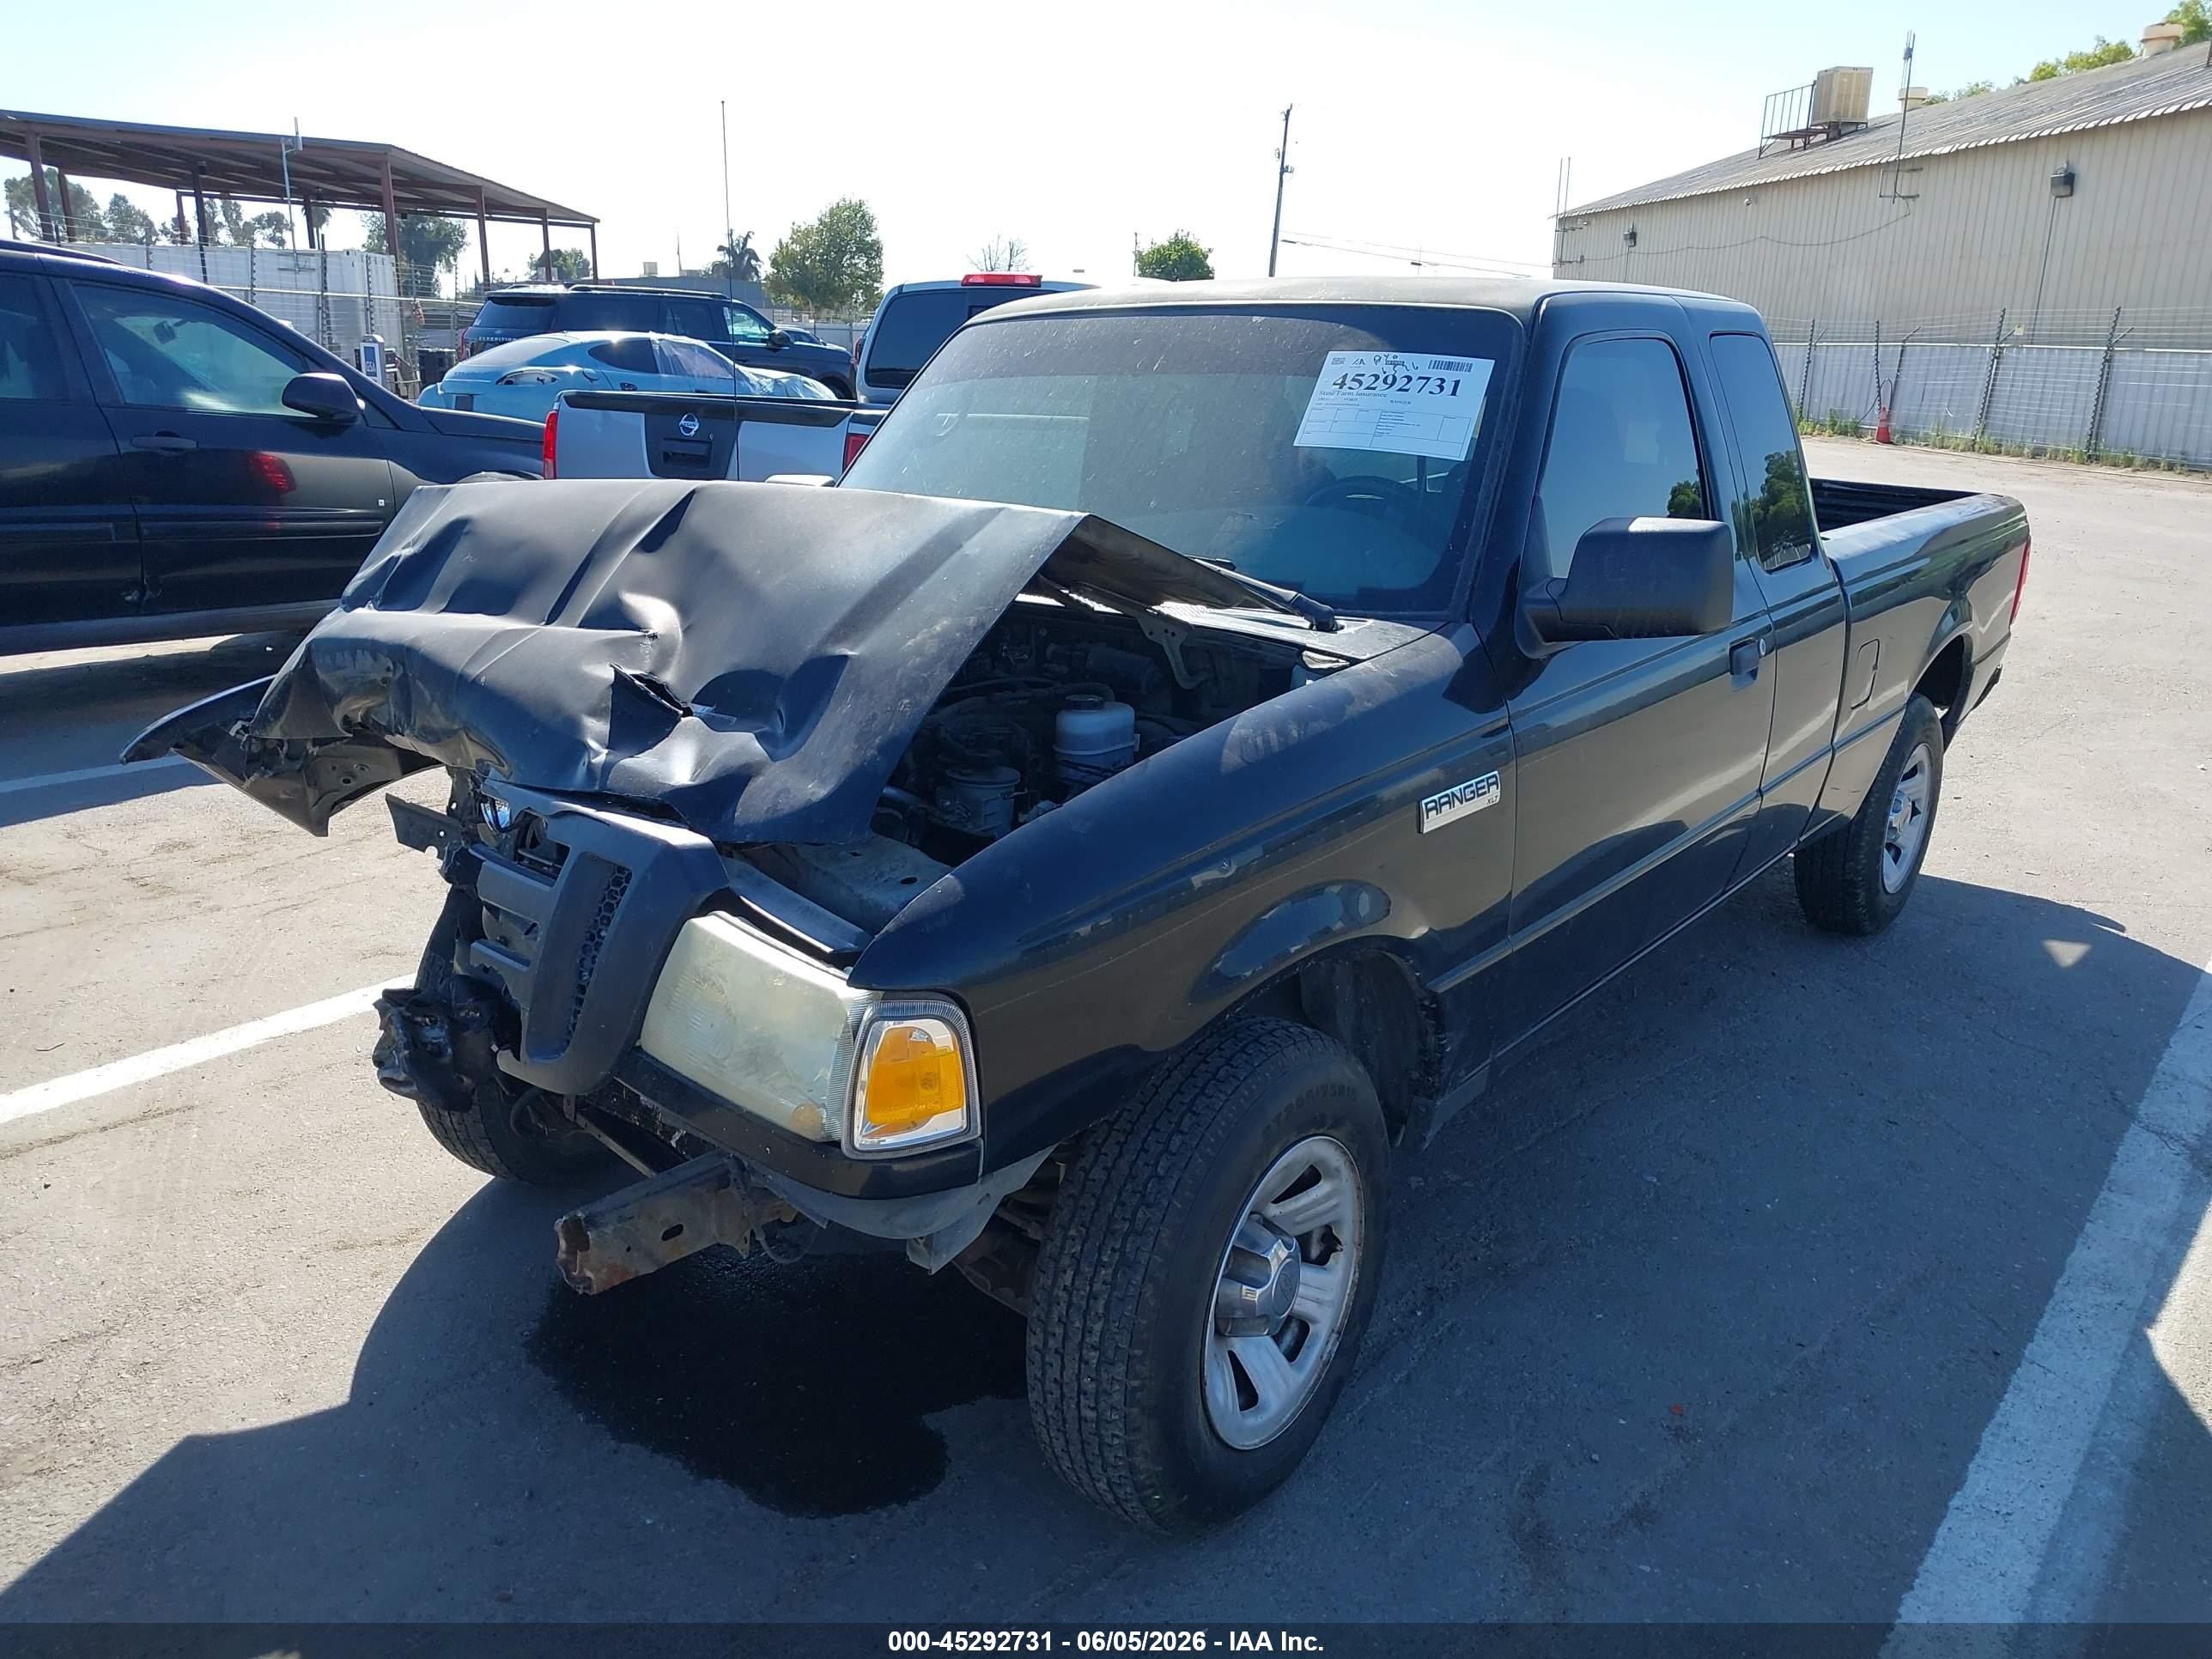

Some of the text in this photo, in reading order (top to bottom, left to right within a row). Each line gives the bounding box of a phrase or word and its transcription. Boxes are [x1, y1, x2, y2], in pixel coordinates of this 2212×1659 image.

[1332, 372, 1462, 397] 45292731
[1423, 775, 1499, 820] RANGER
[1486, 795, 1499, 805] XLT
